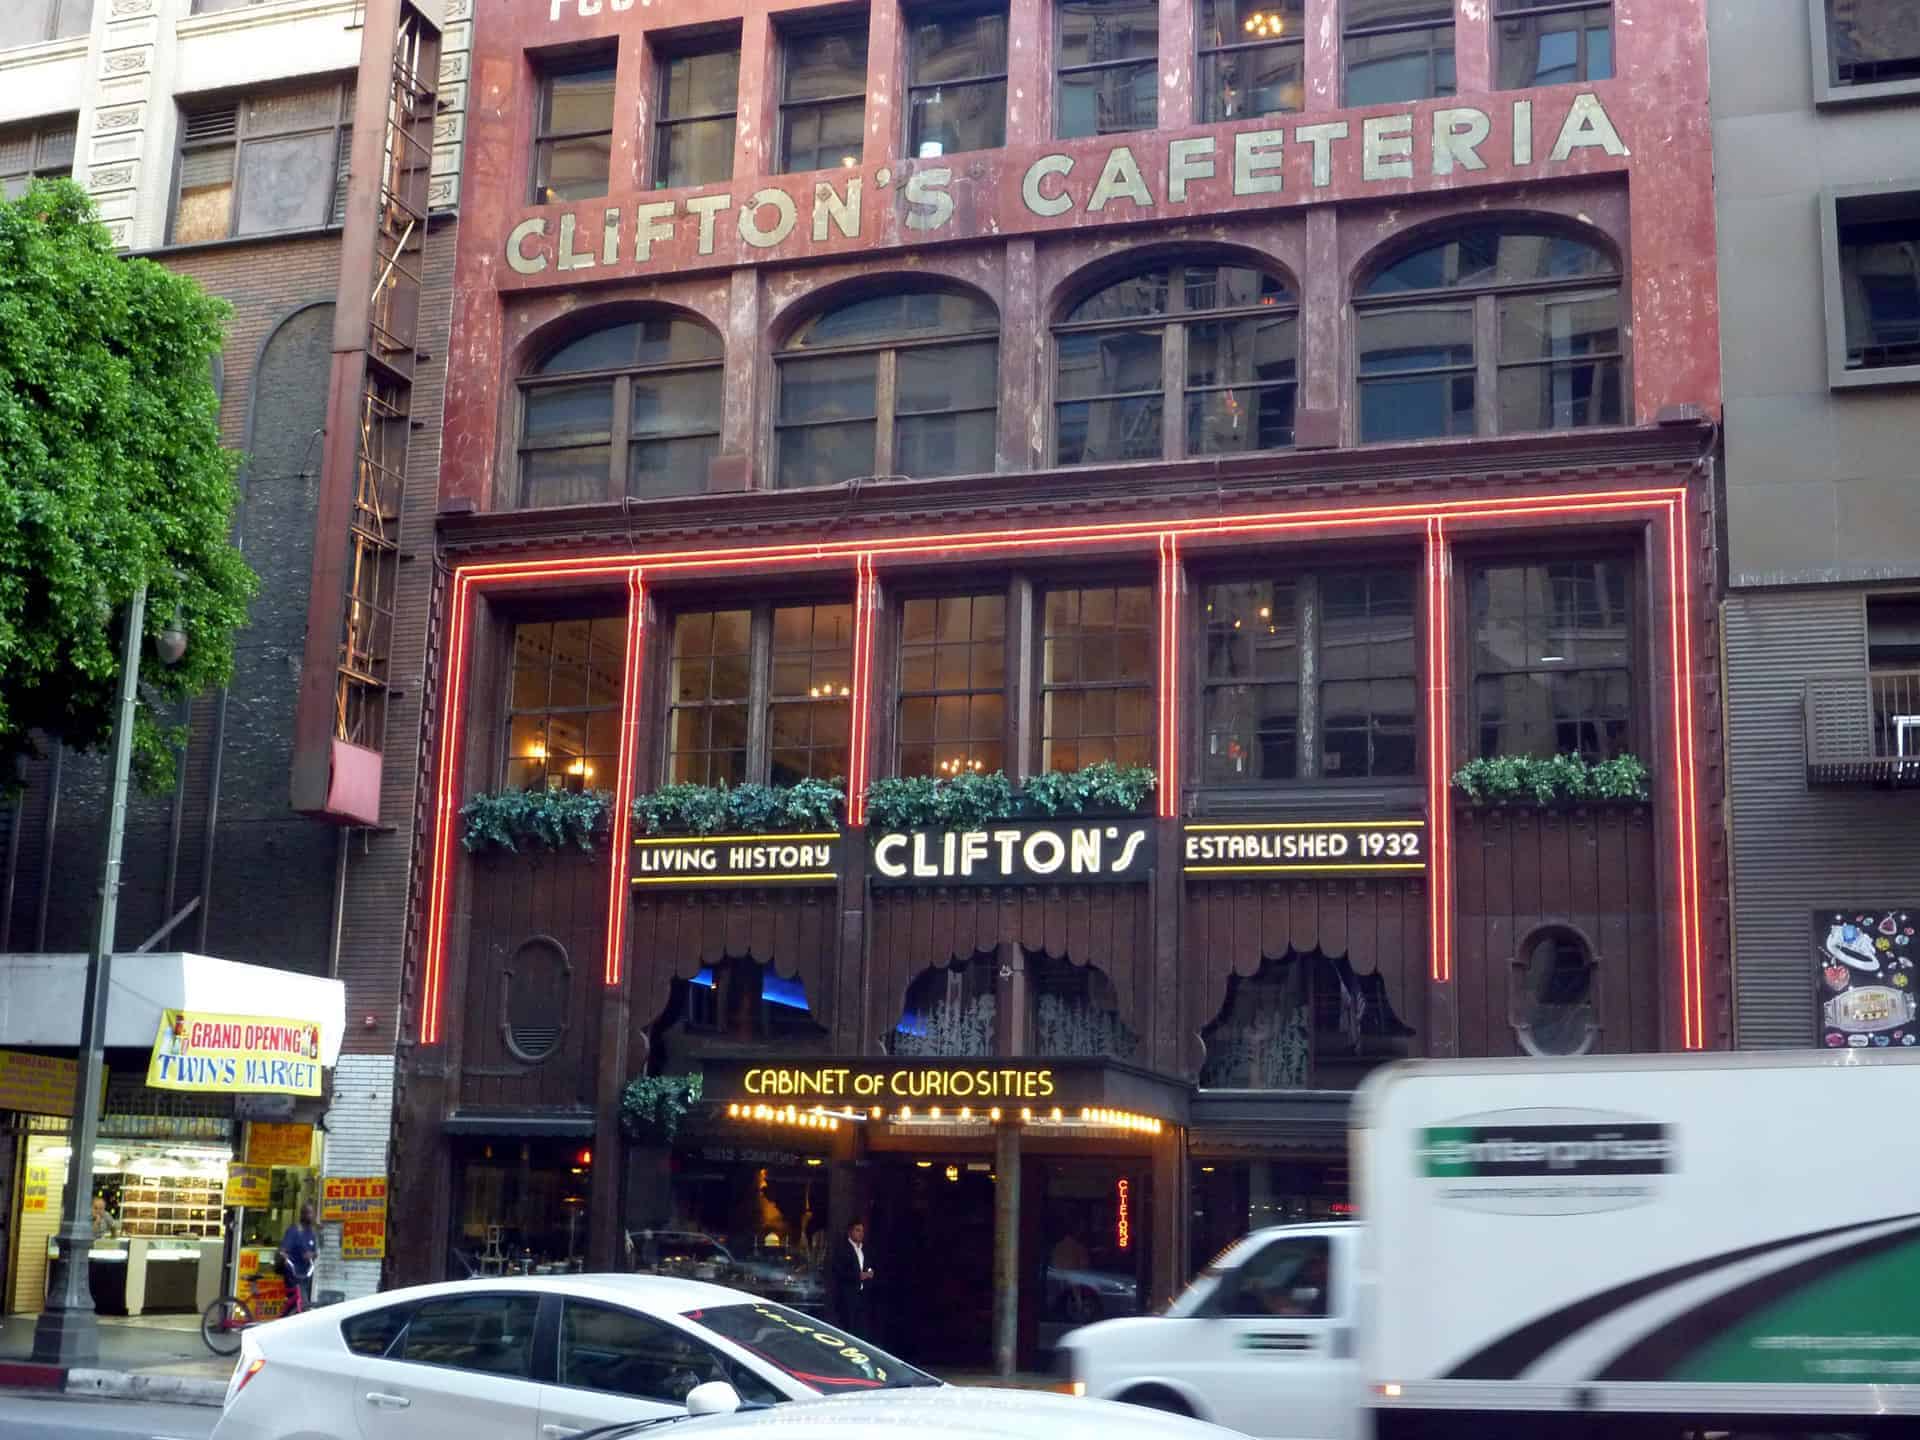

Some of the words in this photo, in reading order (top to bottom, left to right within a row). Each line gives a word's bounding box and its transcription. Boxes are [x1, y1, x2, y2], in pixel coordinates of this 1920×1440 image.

[506, 168, 954, 275] CLIFTON'S
[1021, 94, 1631, 217] CAFETERIA
[641, 845, 717, 871] LIVING
[729, 844, 831, 869] HISTORY
[874, 828, 1147, 878] CLIFTON'S
[1185, 833, 1349, 860] ESTABLISHED
[1357, 832, 1421, 857] 1932
[190, 1022, 241, 1050] GRAND
[244, 1025, 301, 1054] OPENING
[158, 1054, 237, 1084] TWIN'S
[244, 1058, 317, 1089] MARKET
[744, 1069, 850, 1095] CABINET
[890, 1070, 1055, 1098] CURIOSITIES
[326, 1184, 385, 1198] GOLD
